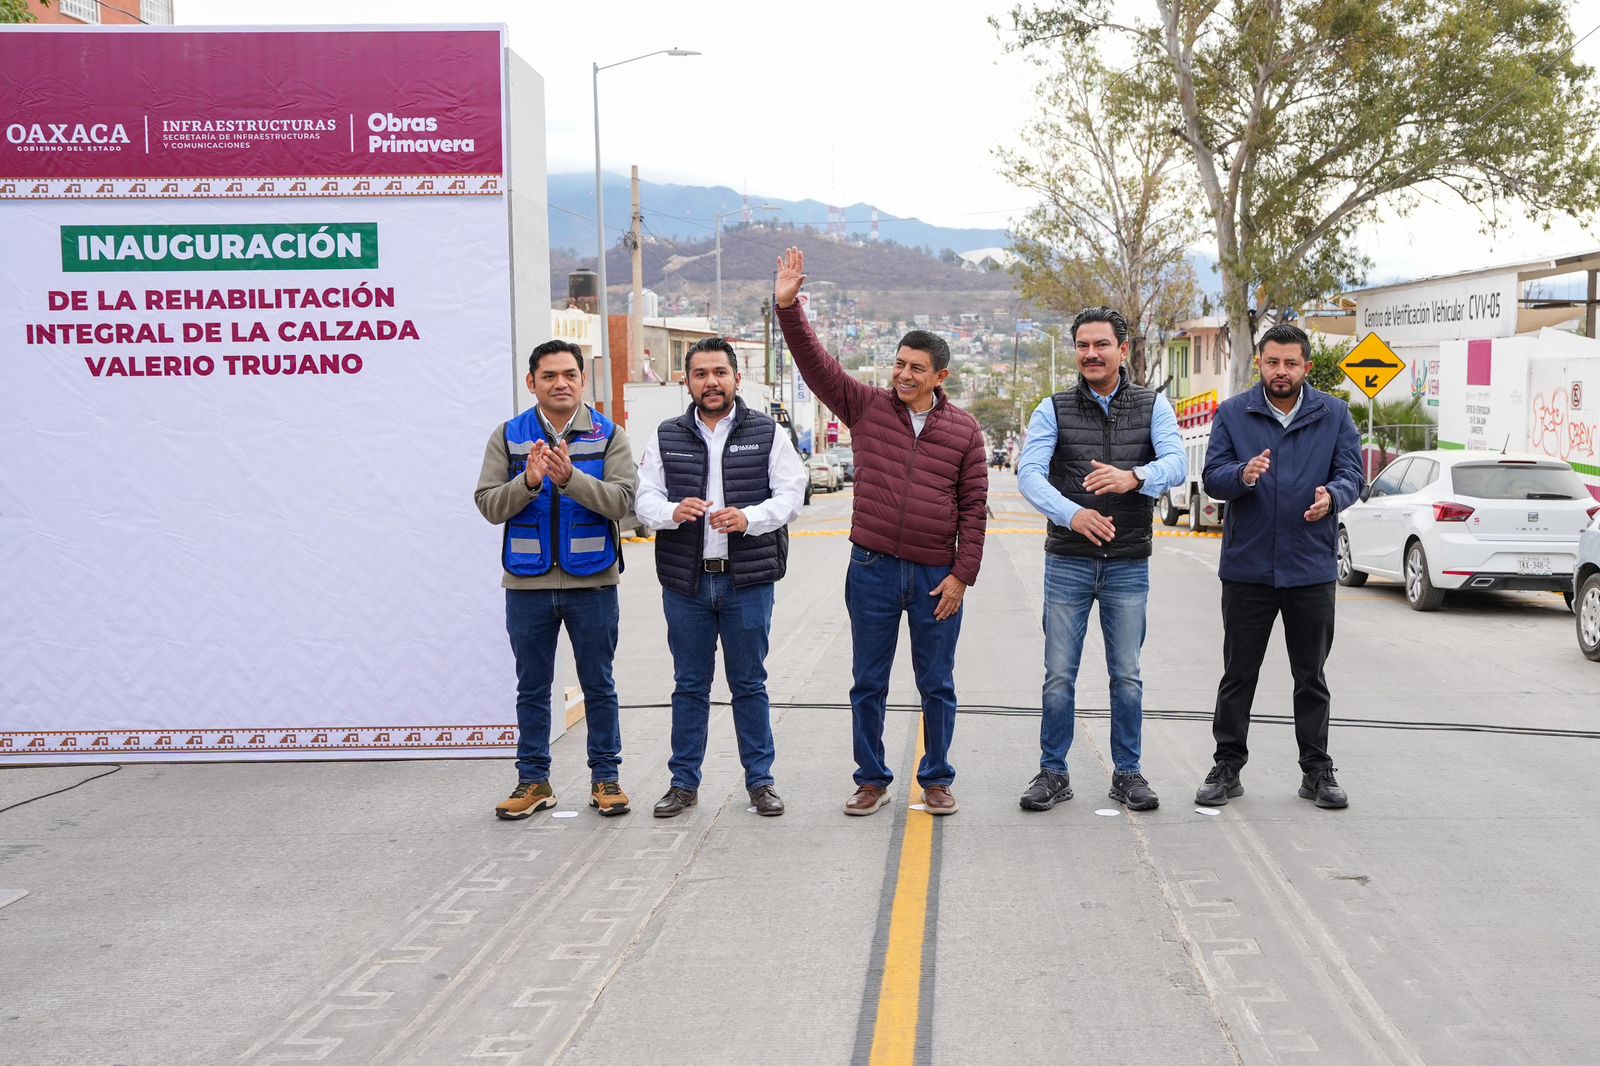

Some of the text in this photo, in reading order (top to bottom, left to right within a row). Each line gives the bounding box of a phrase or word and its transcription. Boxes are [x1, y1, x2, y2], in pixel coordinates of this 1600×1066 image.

[162, 119, 337, 132] INFRAESTRUCTURAS
[367, 112, 438, 133] Obras
[6, 123, 131, 144] OAXACA
[163, 132, 216, 141] SECRETARÍA
[233, 132, 321, 140] INFRAESTRUCTURAS
[368, 134, 475, 154] Primavera
[171, 141, 251, 149] COMUNICACIONES
[77, 226, 362, 261] INAUGURACIÓN
[48, 281, 395, 311] DE LA REHABILITACIÓN
[1364, 292, 1501, 327] Centro de Verificación Vehicular CVV-05
[26, 319, 421, 345] INTEGRAL DE LA CALZADA
[84, 353, 364, 378] VALERIO TRUJANO
